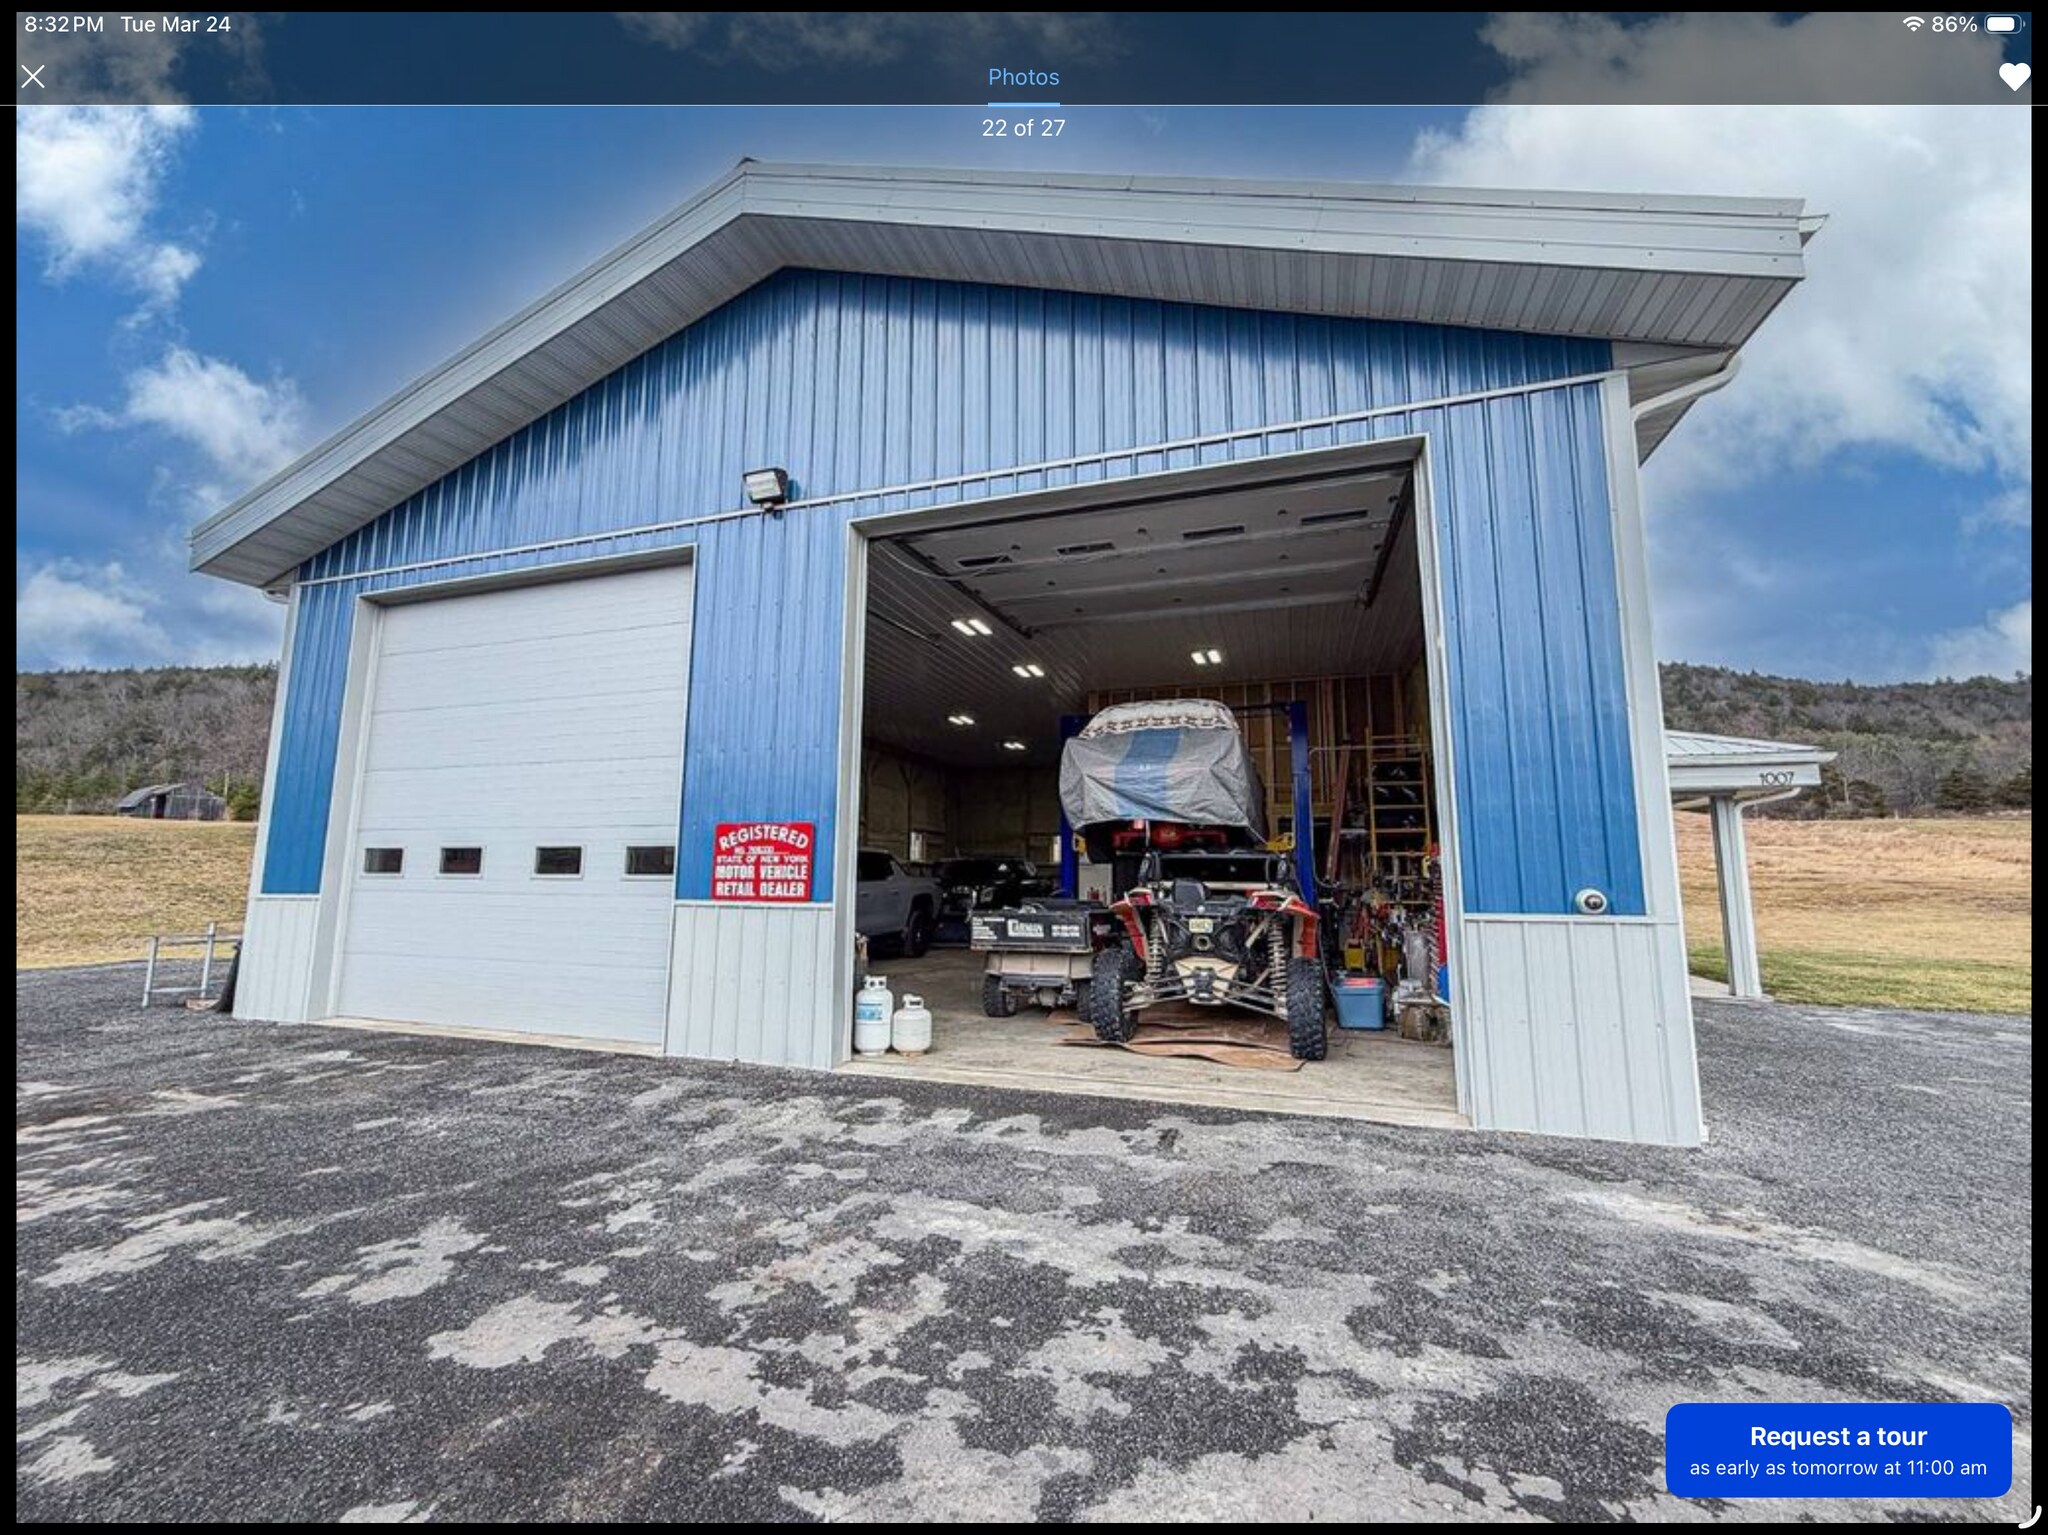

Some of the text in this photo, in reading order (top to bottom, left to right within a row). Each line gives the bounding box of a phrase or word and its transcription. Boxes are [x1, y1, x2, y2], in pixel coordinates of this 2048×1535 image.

[1759, 771, 1795, 786] 1007
[719, 825, 809, 850] REGISTERED
[760, 855, 780, 863] NEW
[715, 865, 808, 880] MOTOR VEHICLE
[715, 881, 805, 896] RETAIL DEALER
